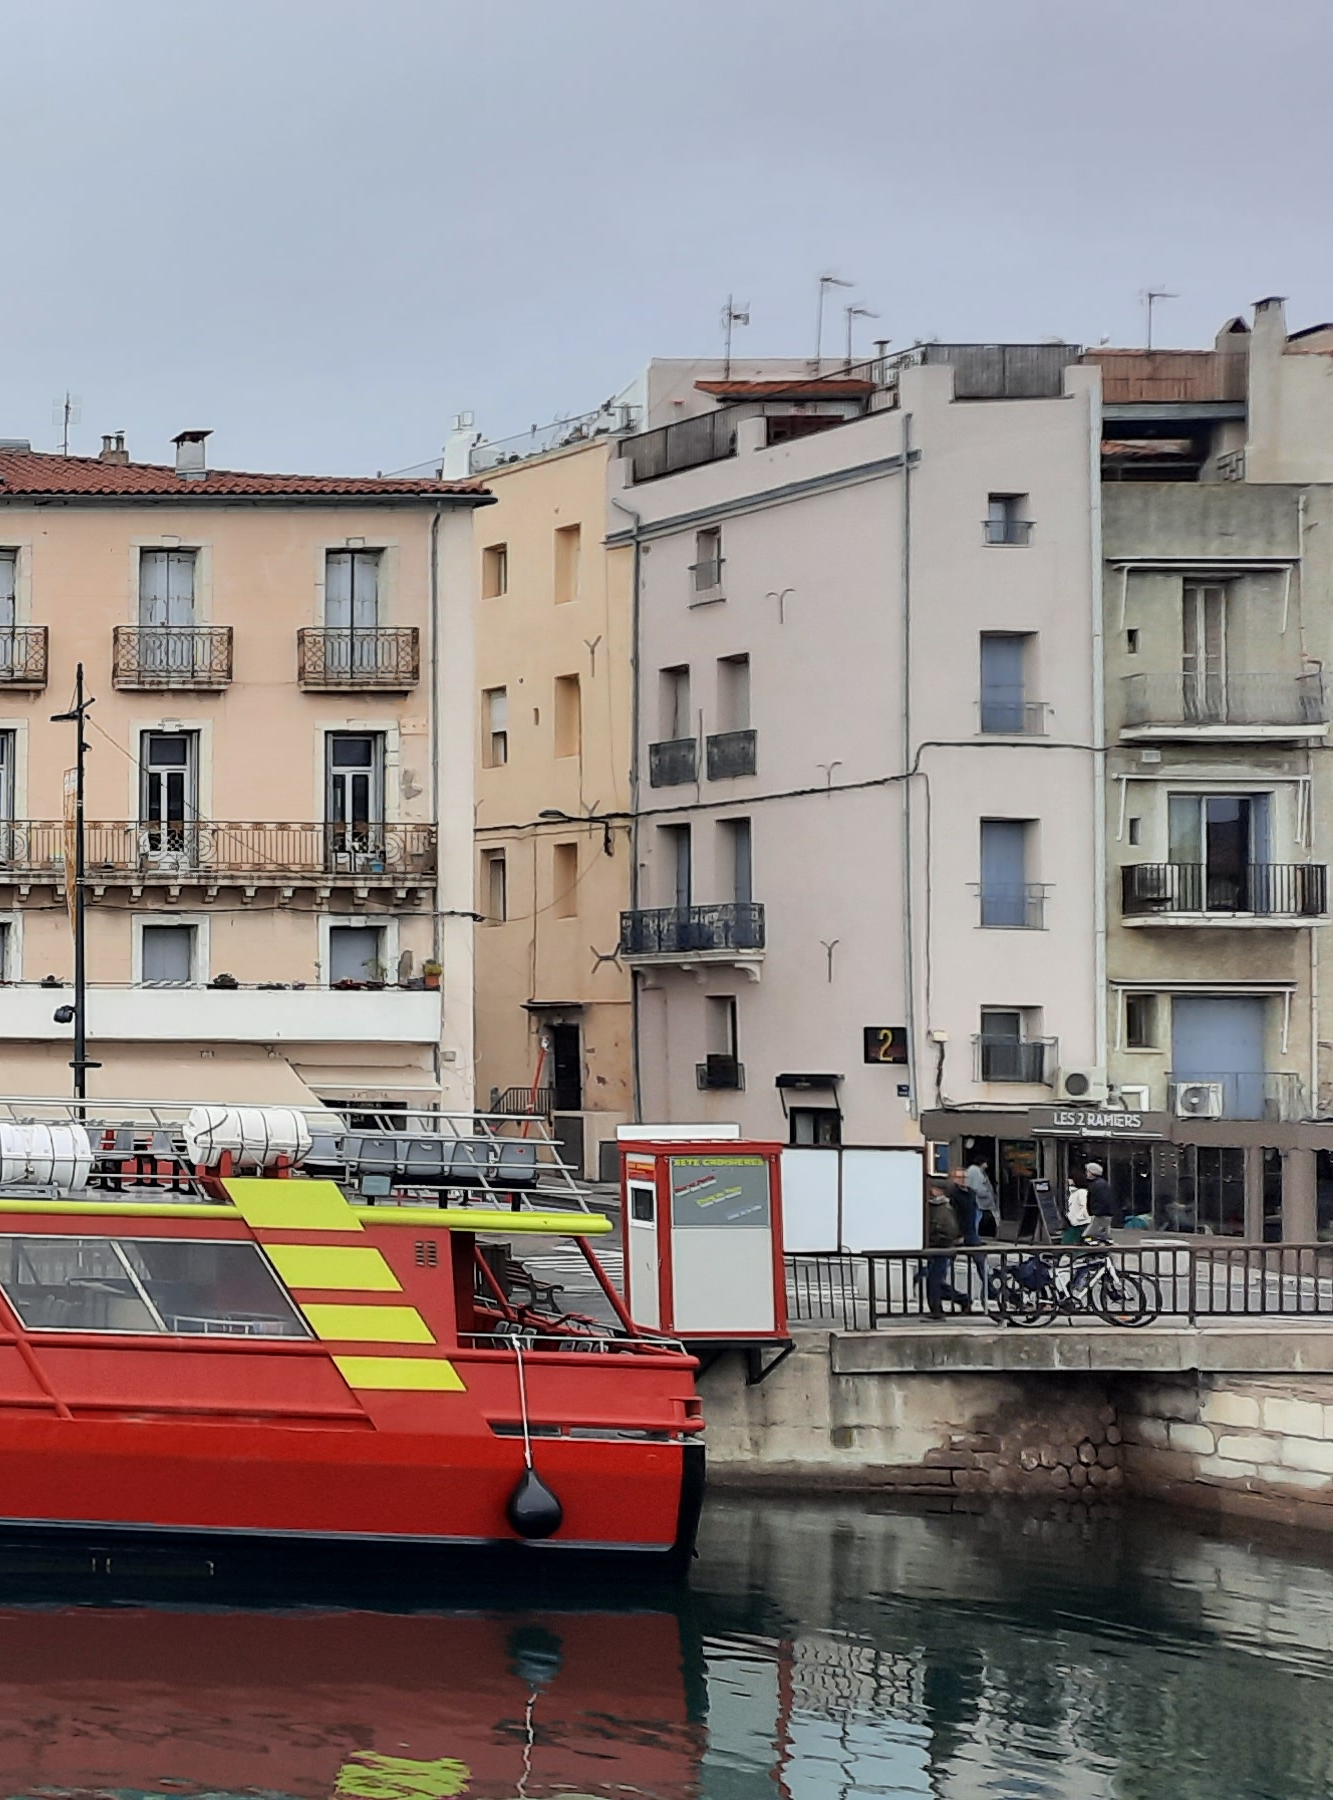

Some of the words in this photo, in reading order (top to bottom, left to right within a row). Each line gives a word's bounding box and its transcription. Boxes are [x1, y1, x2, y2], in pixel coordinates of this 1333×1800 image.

[879, 1029, 893, 1062] 2
[1053, 1111, 1075, 1126] LES
[1076, 1112, 1085, 1126] 2
[1086, 1112, 1142, 1128] RAMIERS
